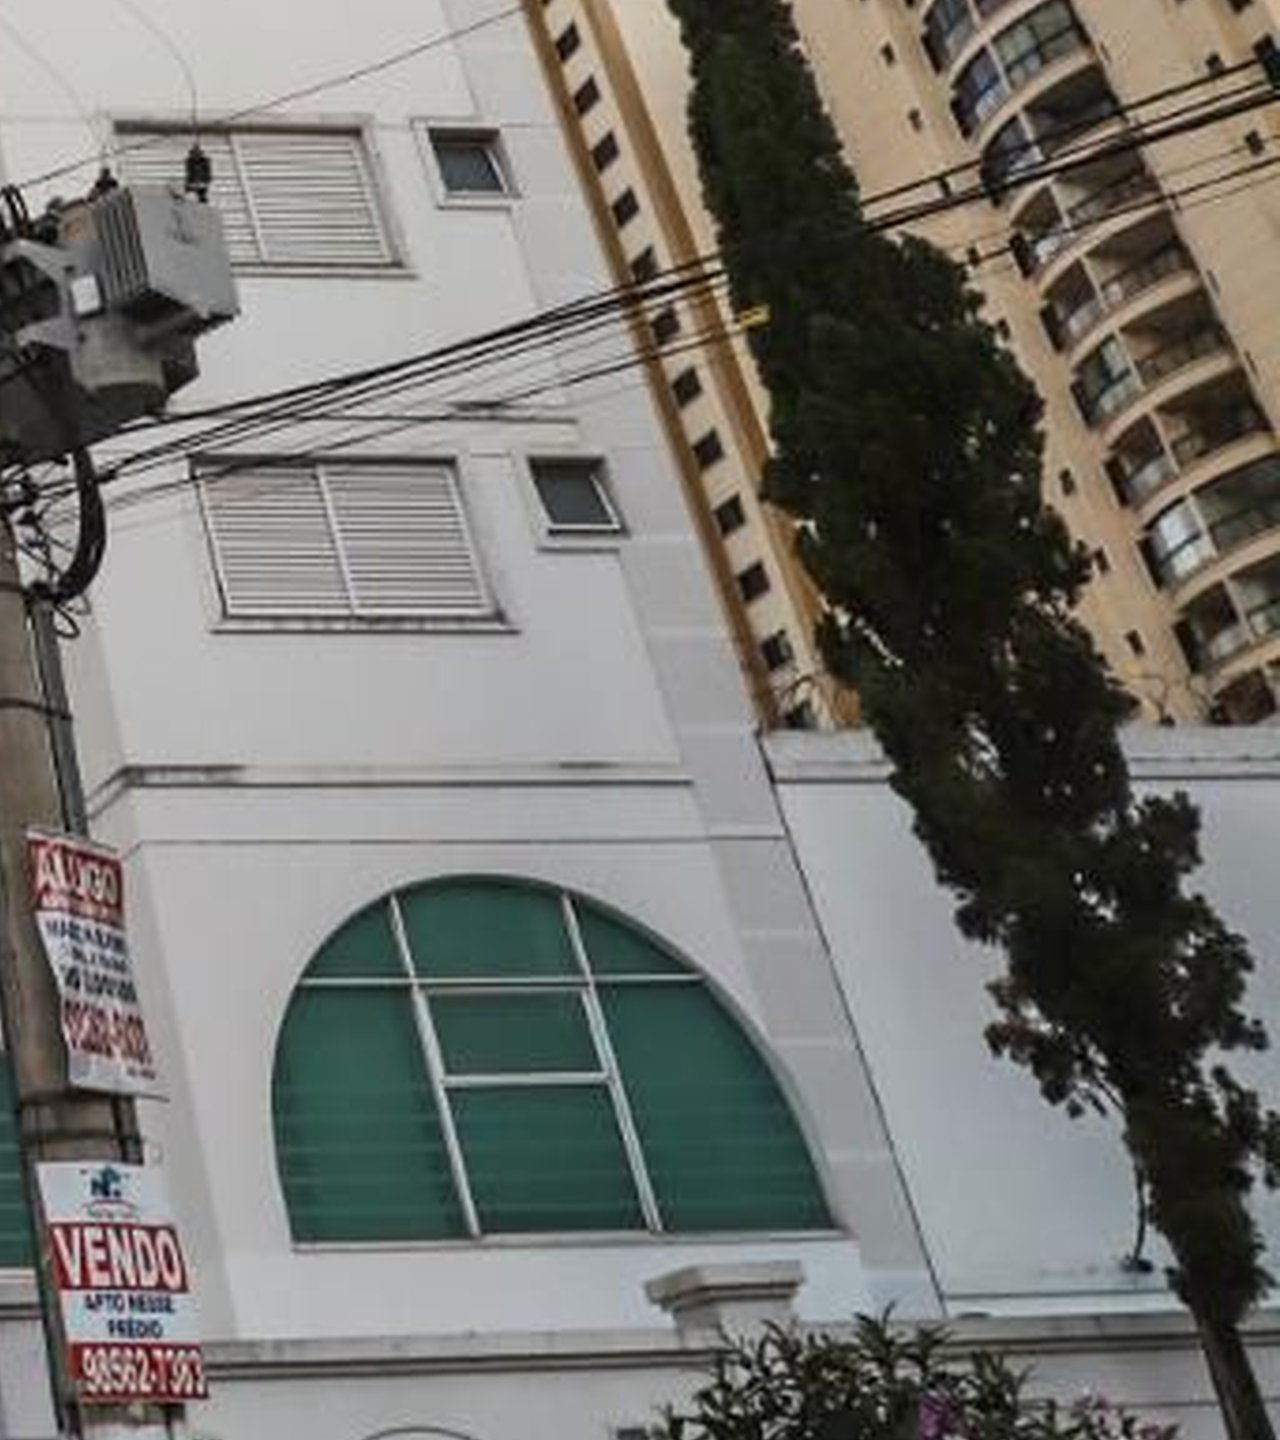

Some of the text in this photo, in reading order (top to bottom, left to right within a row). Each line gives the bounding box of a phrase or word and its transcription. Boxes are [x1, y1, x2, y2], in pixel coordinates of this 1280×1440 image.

[37, 843, 118, 905] ALUGO
[52, 1228, 182, 1290] VENDO
[84, 1293, 125, 1312] APTO
